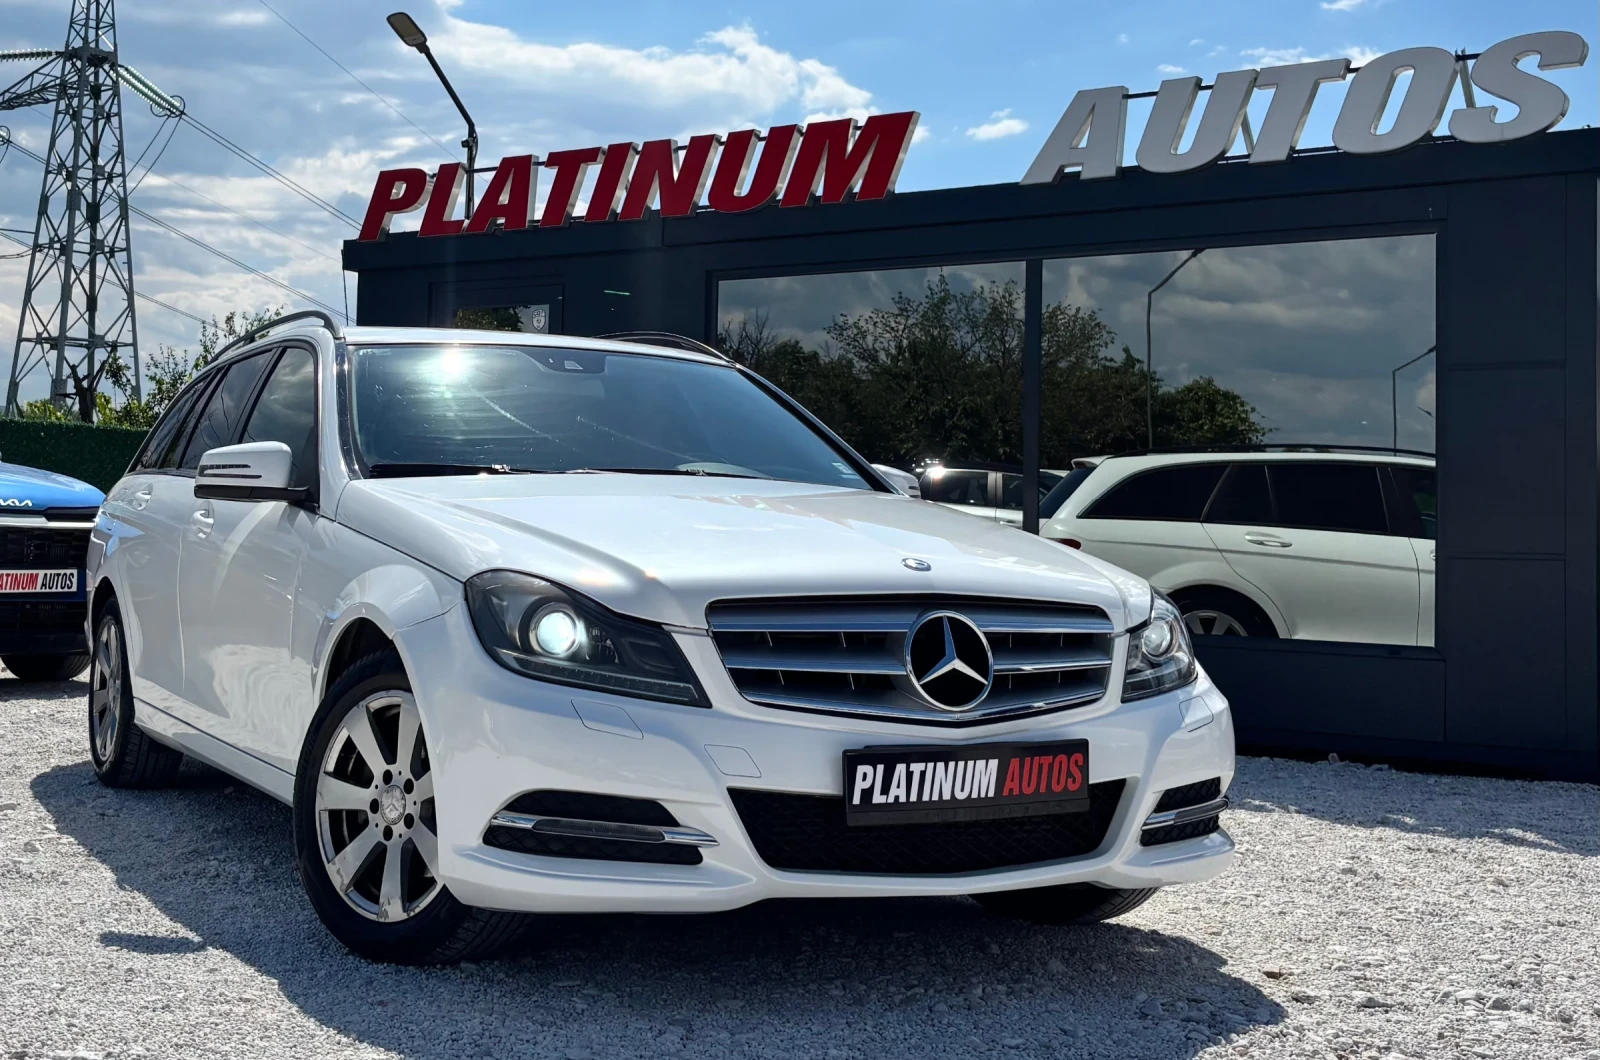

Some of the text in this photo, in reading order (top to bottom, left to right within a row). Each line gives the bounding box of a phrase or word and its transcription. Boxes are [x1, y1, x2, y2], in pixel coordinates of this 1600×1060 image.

[357, 30, 1589, 242] PLATINUM AUTOS
[40, 572, 75, 590] AUTOS
[852, 753, 1084, 805] PLATINUM AUTOS
